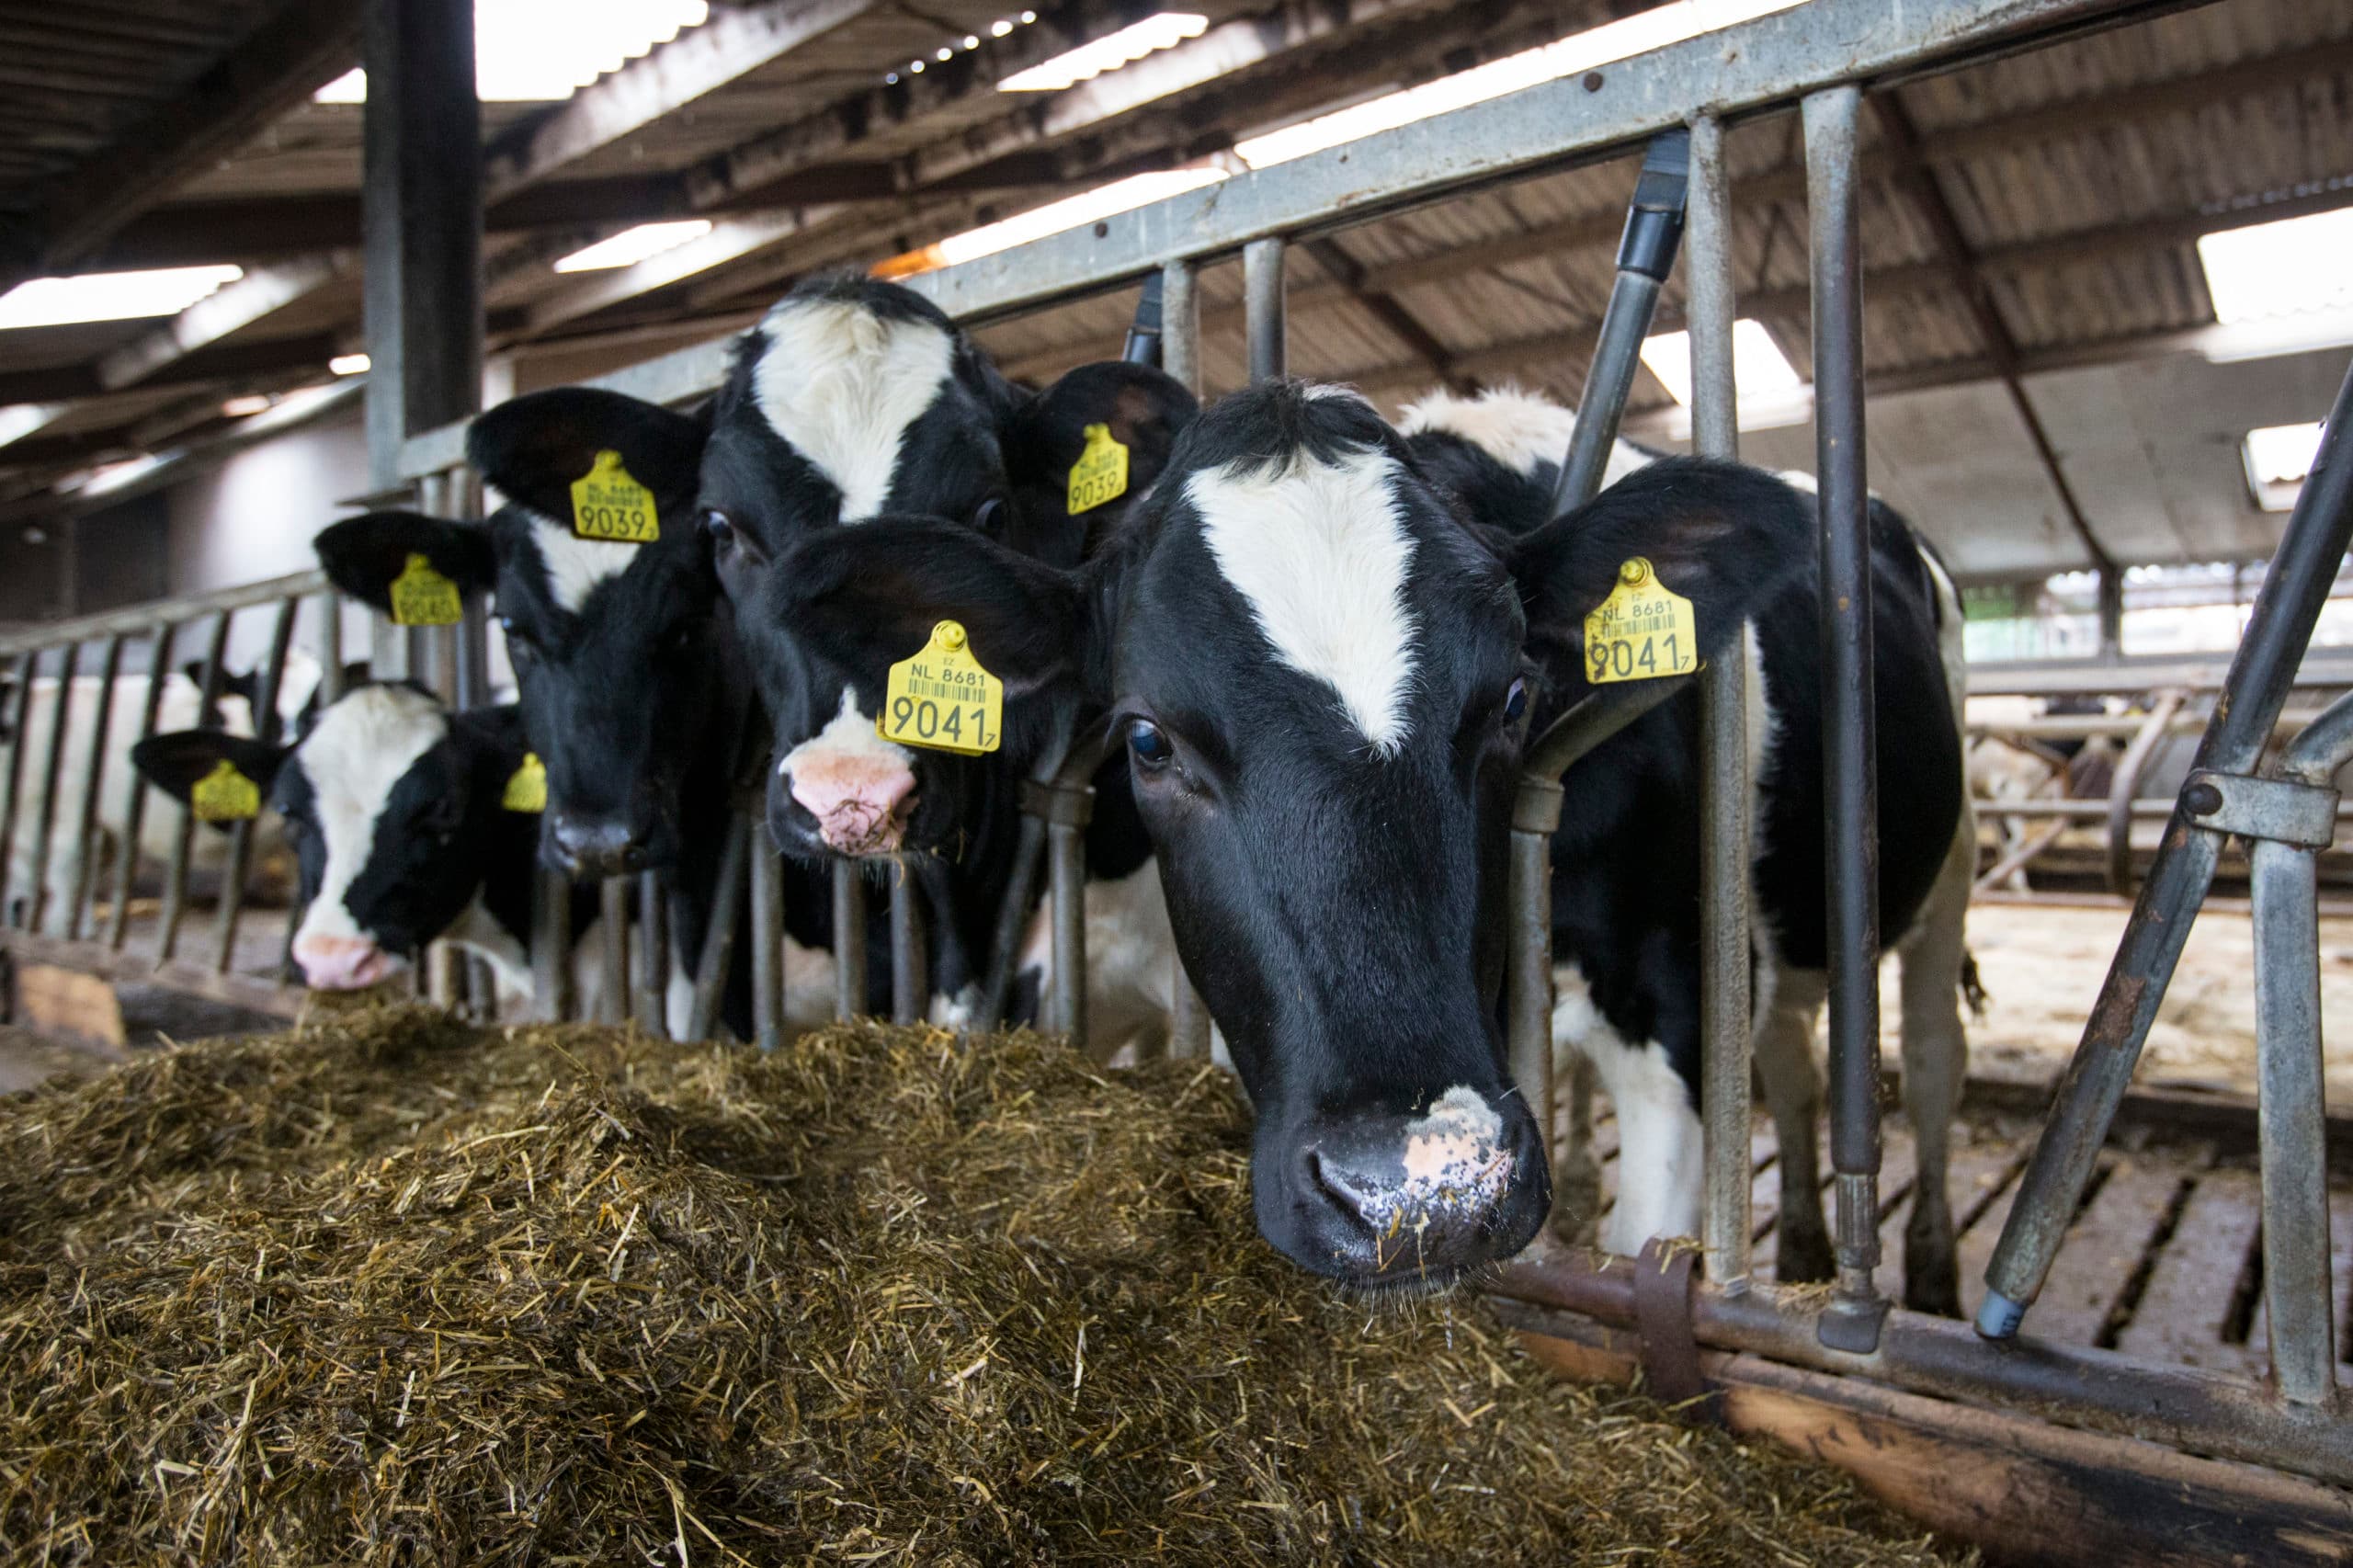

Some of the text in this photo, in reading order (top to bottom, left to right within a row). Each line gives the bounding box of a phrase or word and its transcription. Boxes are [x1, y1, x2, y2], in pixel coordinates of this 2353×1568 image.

[1073, 471, 1117, 510] 9039
[580, 505, 645, 537] 9039
[1632, 599, 1673, 618] 8681
[1590, 632, 1690, 680] 9041 7
[911, 663, 984, 687] NL 8681
[893, 696, 996, 747] 9041 7
